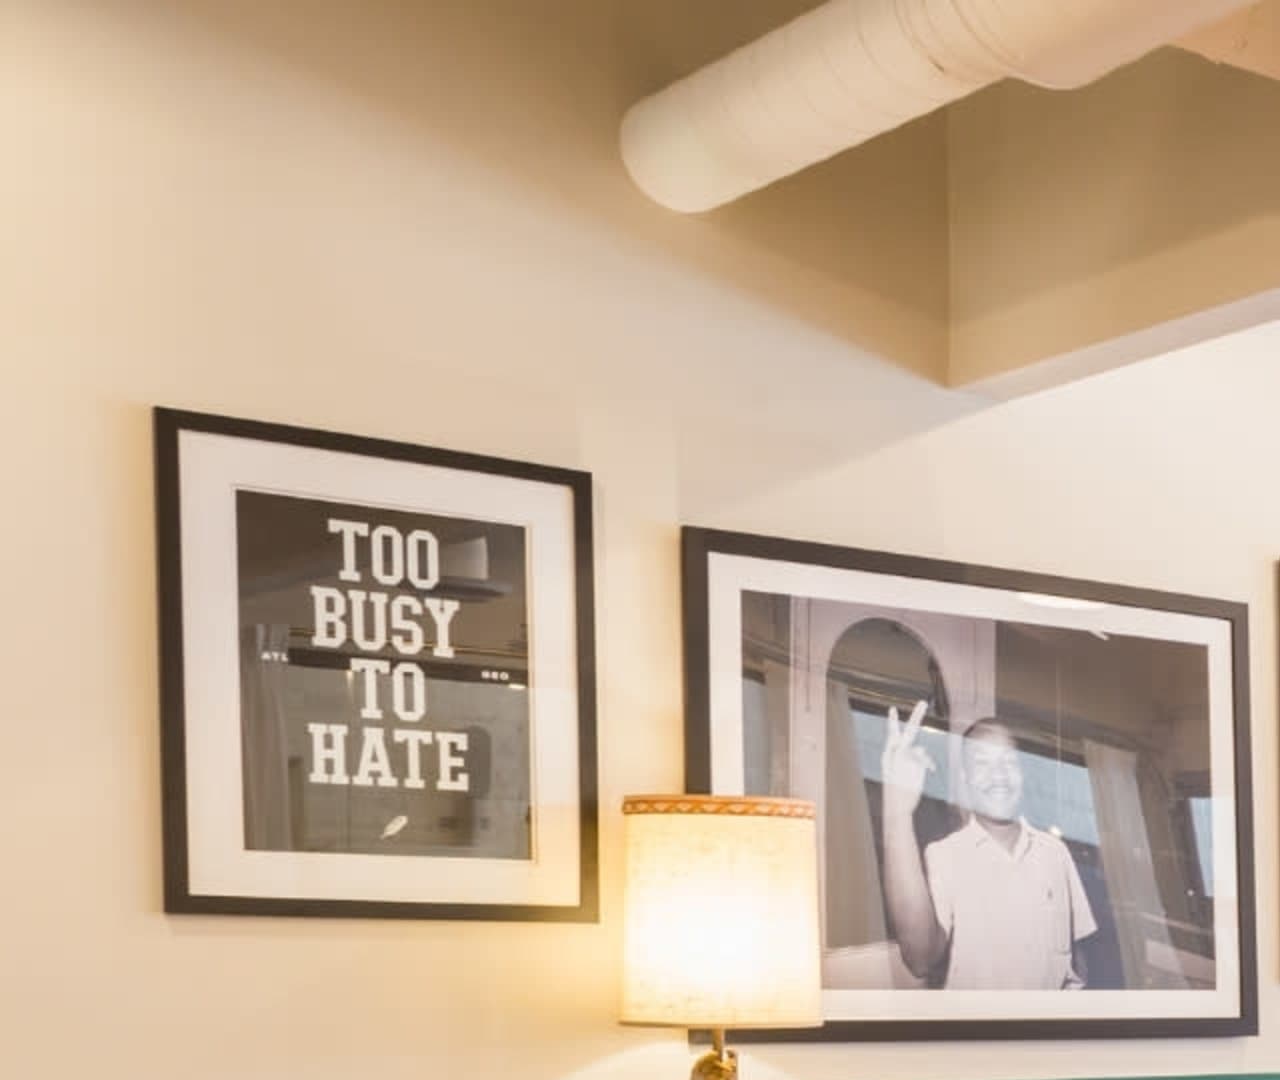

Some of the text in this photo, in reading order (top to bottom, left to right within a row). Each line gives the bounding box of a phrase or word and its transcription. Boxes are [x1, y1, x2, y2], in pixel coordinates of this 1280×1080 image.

[328, 518, 439, 590] TOO
[309, 585, 460, 658] BUSY
[350, 657, 426, 722] TO
[308, 723, 469, 791] HATE
